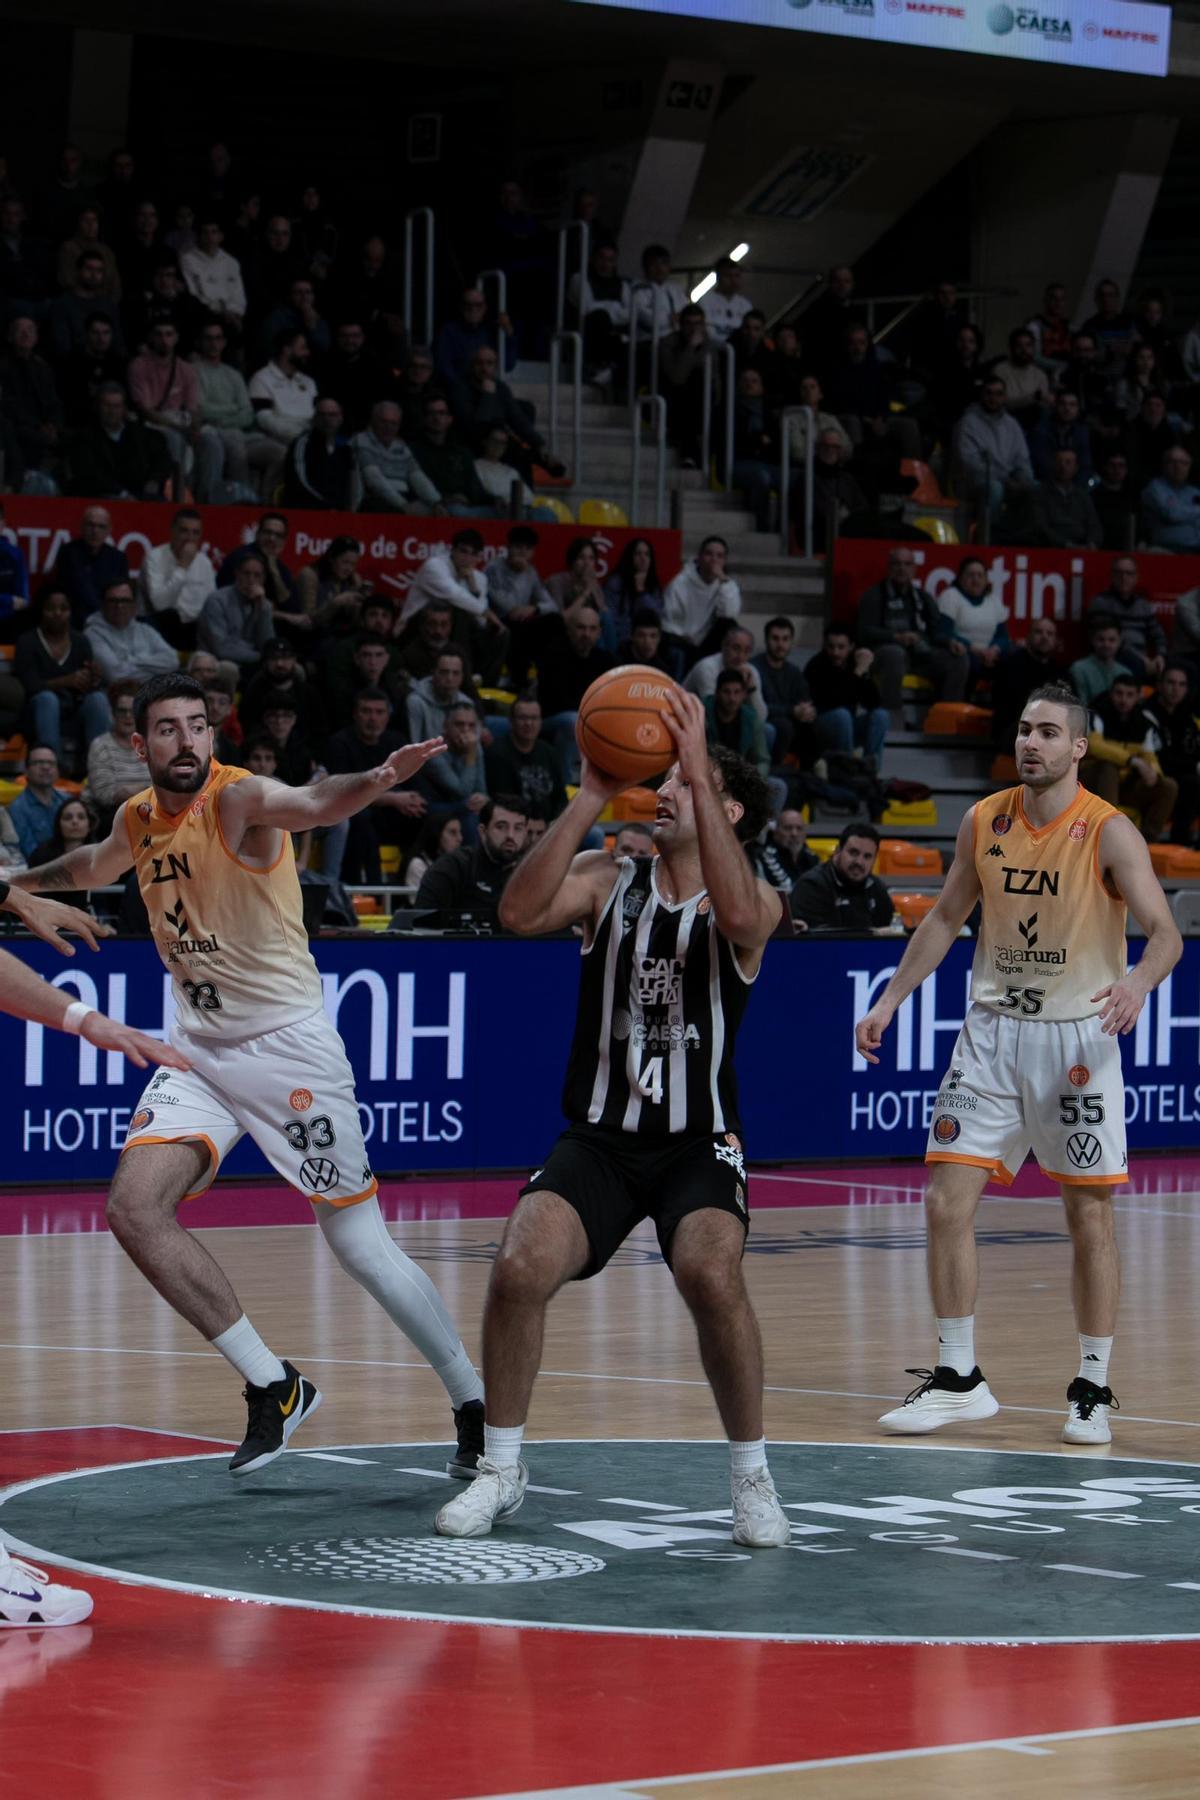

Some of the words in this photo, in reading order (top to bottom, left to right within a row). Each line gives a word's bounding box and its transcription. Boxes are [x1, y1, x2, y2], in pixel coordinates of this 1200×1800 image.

[906, 3, 966, 18] MAPFRE
[1017, 15, 1072, 35] CAESA
[1103, 28, 1158, 44] MAPFRE
[371, 534, 399, 560] de
[1002, 867, 1060, 896] TZN
[999, 985, 1046, 1017] 55
[634, 1024, 701, 1042] CAESA
[638, 1056, 664, 1105] 4
[358, 1099, 464, 1143] OTELS
[850, 1089, 938, 1132] HOTE
[1060, 1093, 1105, 1127] 55
[23, 1107, 131, 1153] HOTE
[283, 1114, 336, 1152] 33
[665, 1504, 1200, 1563] SEGUR
